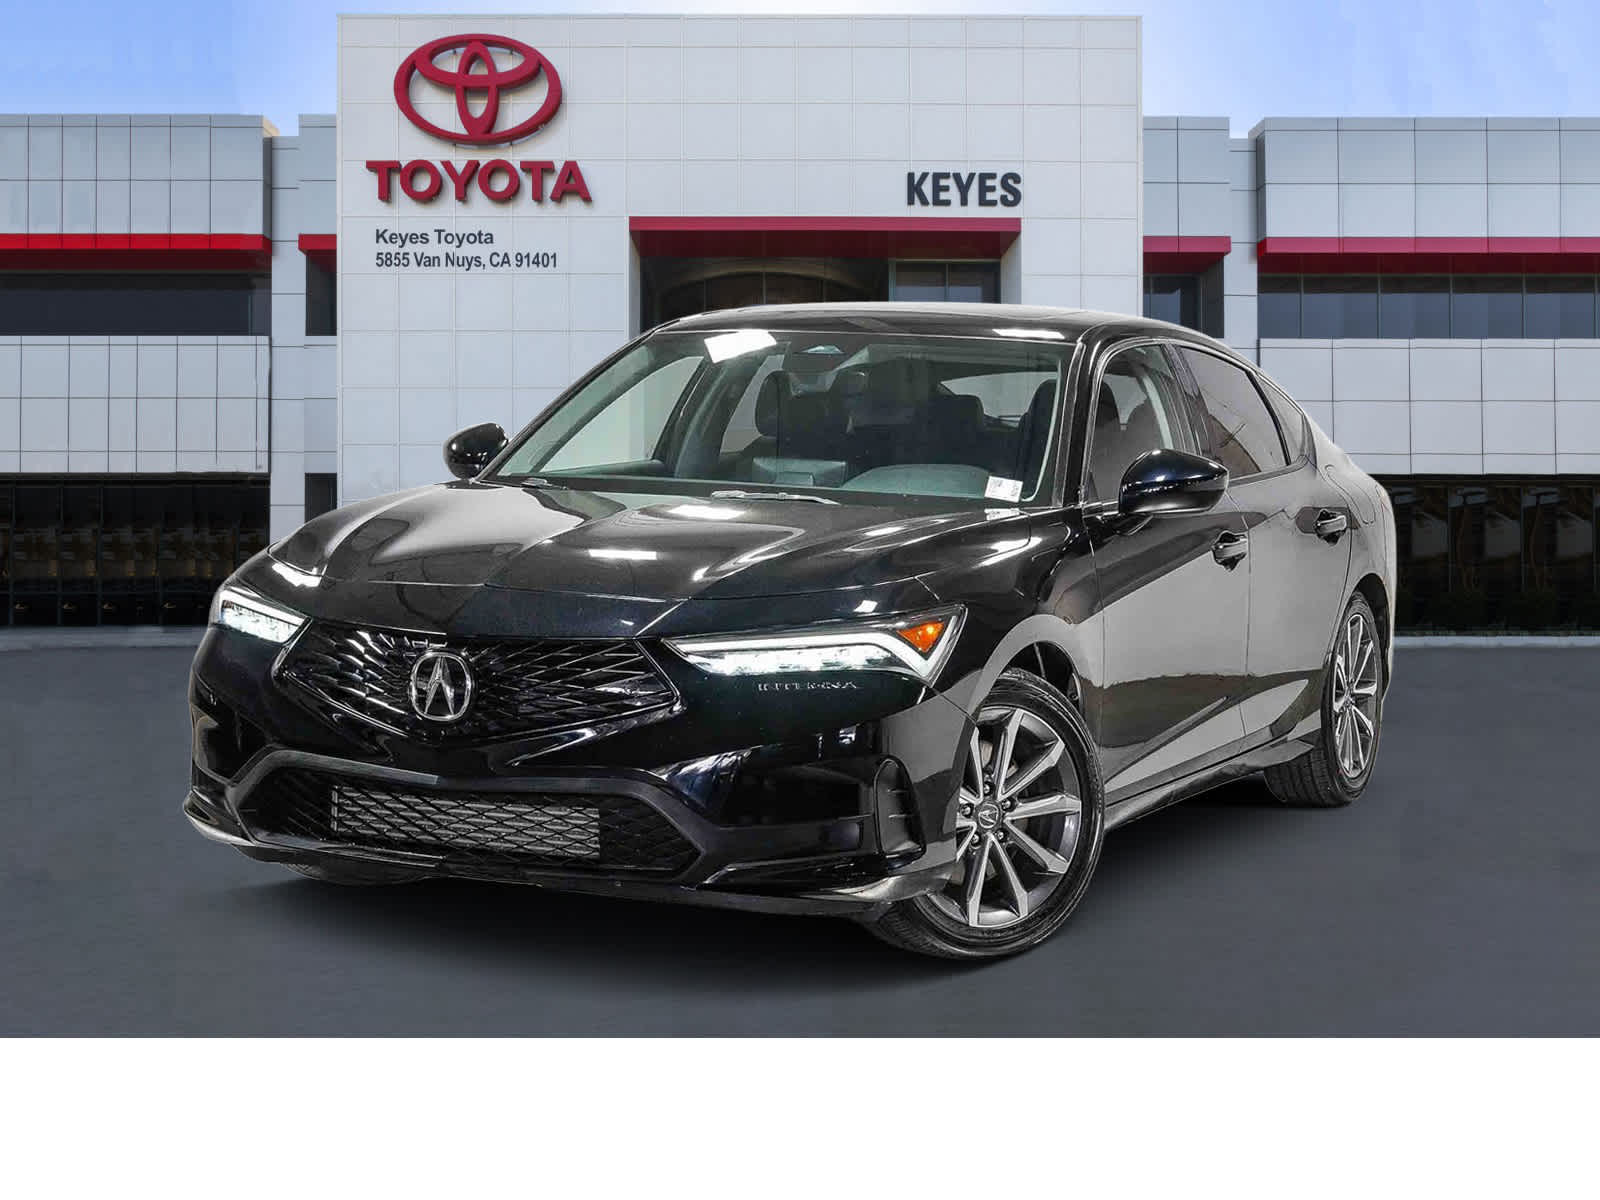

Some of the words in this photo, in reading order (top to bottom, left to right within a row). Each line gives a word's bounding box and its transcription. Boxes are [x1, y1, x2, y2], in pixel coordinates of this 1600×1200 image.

[365, 159, 592, 203] TOYOTA
[907, 171, 1022, 207] KEYES
[375, 228, 430, 248] Keyes
[434, 228, 495, 248] Toyota
[375, 252, 410, 268] 5855
[414, 252, 441, 268] Van
[445, 252, 486, 271] Nuys,
[489, 252, 511, 268] CA
[515, 252, 557, 268] 91401
